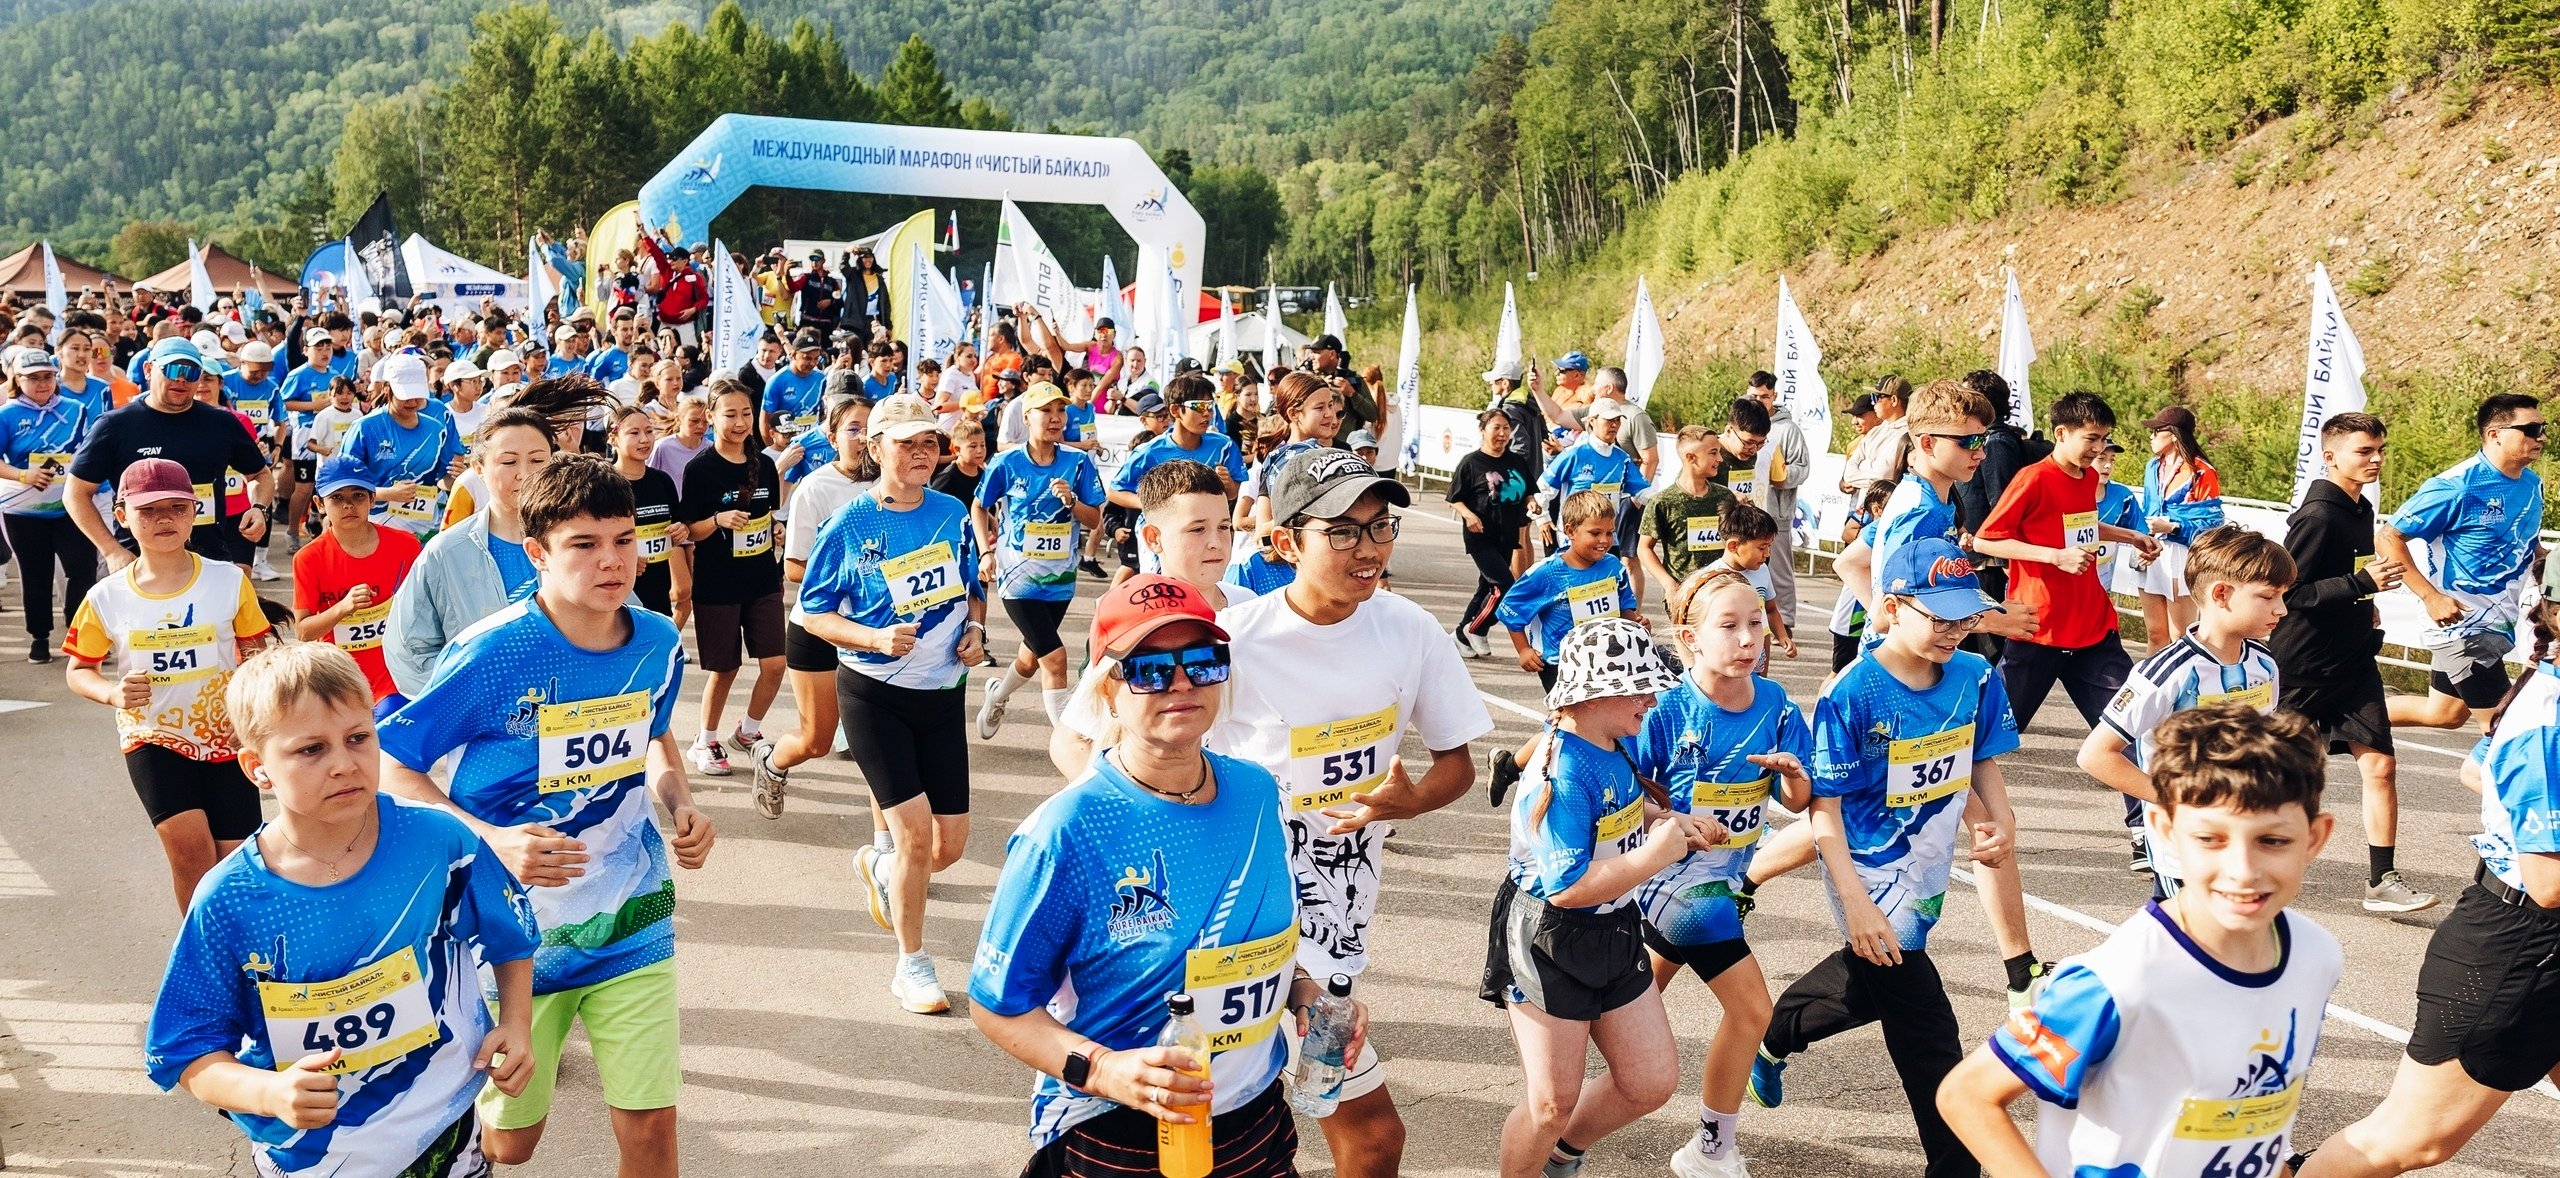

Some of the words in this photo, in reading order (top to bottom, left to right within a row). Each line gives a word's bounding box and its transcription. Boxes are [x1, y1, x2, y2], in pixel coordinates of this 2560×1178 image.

[752, 139, 897, 167] МЕЖДУНАРОДНЫЙ
[900, 150, 972, 170] МАРАФОН
[975, 155, 1043, 175] «ЧИСТЫЙ
[1045, 158, 1112, 179] БАЙКАЛ»
[720, 319, 731, 368] ИСТЫЙ
[1736, 482, 1752, 494] 428
[645, 537, 666, 554] 157
[746, 529, 767, 547] 547
[1036, 537, 1061, 551] 218
[1697, 530, 1721, 542] 446
[2076, 528, 2094, 543] 419
[906, 566, 946, 597] 227
[903, 604, 910, 612] 3
[1586, 597, 1610, 616] 115
[348, 620, 387, 641] 256
[152, 648, 198, 673] 541
[564, 728, 632, 769] 504
[1322, 746, 1376, 786] 531
[1911, 754, 1956, 789] 367
[550, 779, 560, 788] 3
[1302, 797, 1312, 806] 3
[1712, 806, 1761, 833] 368
[1108, 919, 1133, 933] PURE
[1135, 911, 1171, 926] BAIKAL
[311, 985, 349, 998] «ЧИСТЫЙ
[349, 971, 384, 990] БАЙКАЛ»
[1219, 973, 1282, 1026] 517
[302, 1002, 396, 1053] 489
[2200, 1134, 2283, 1178] 469
